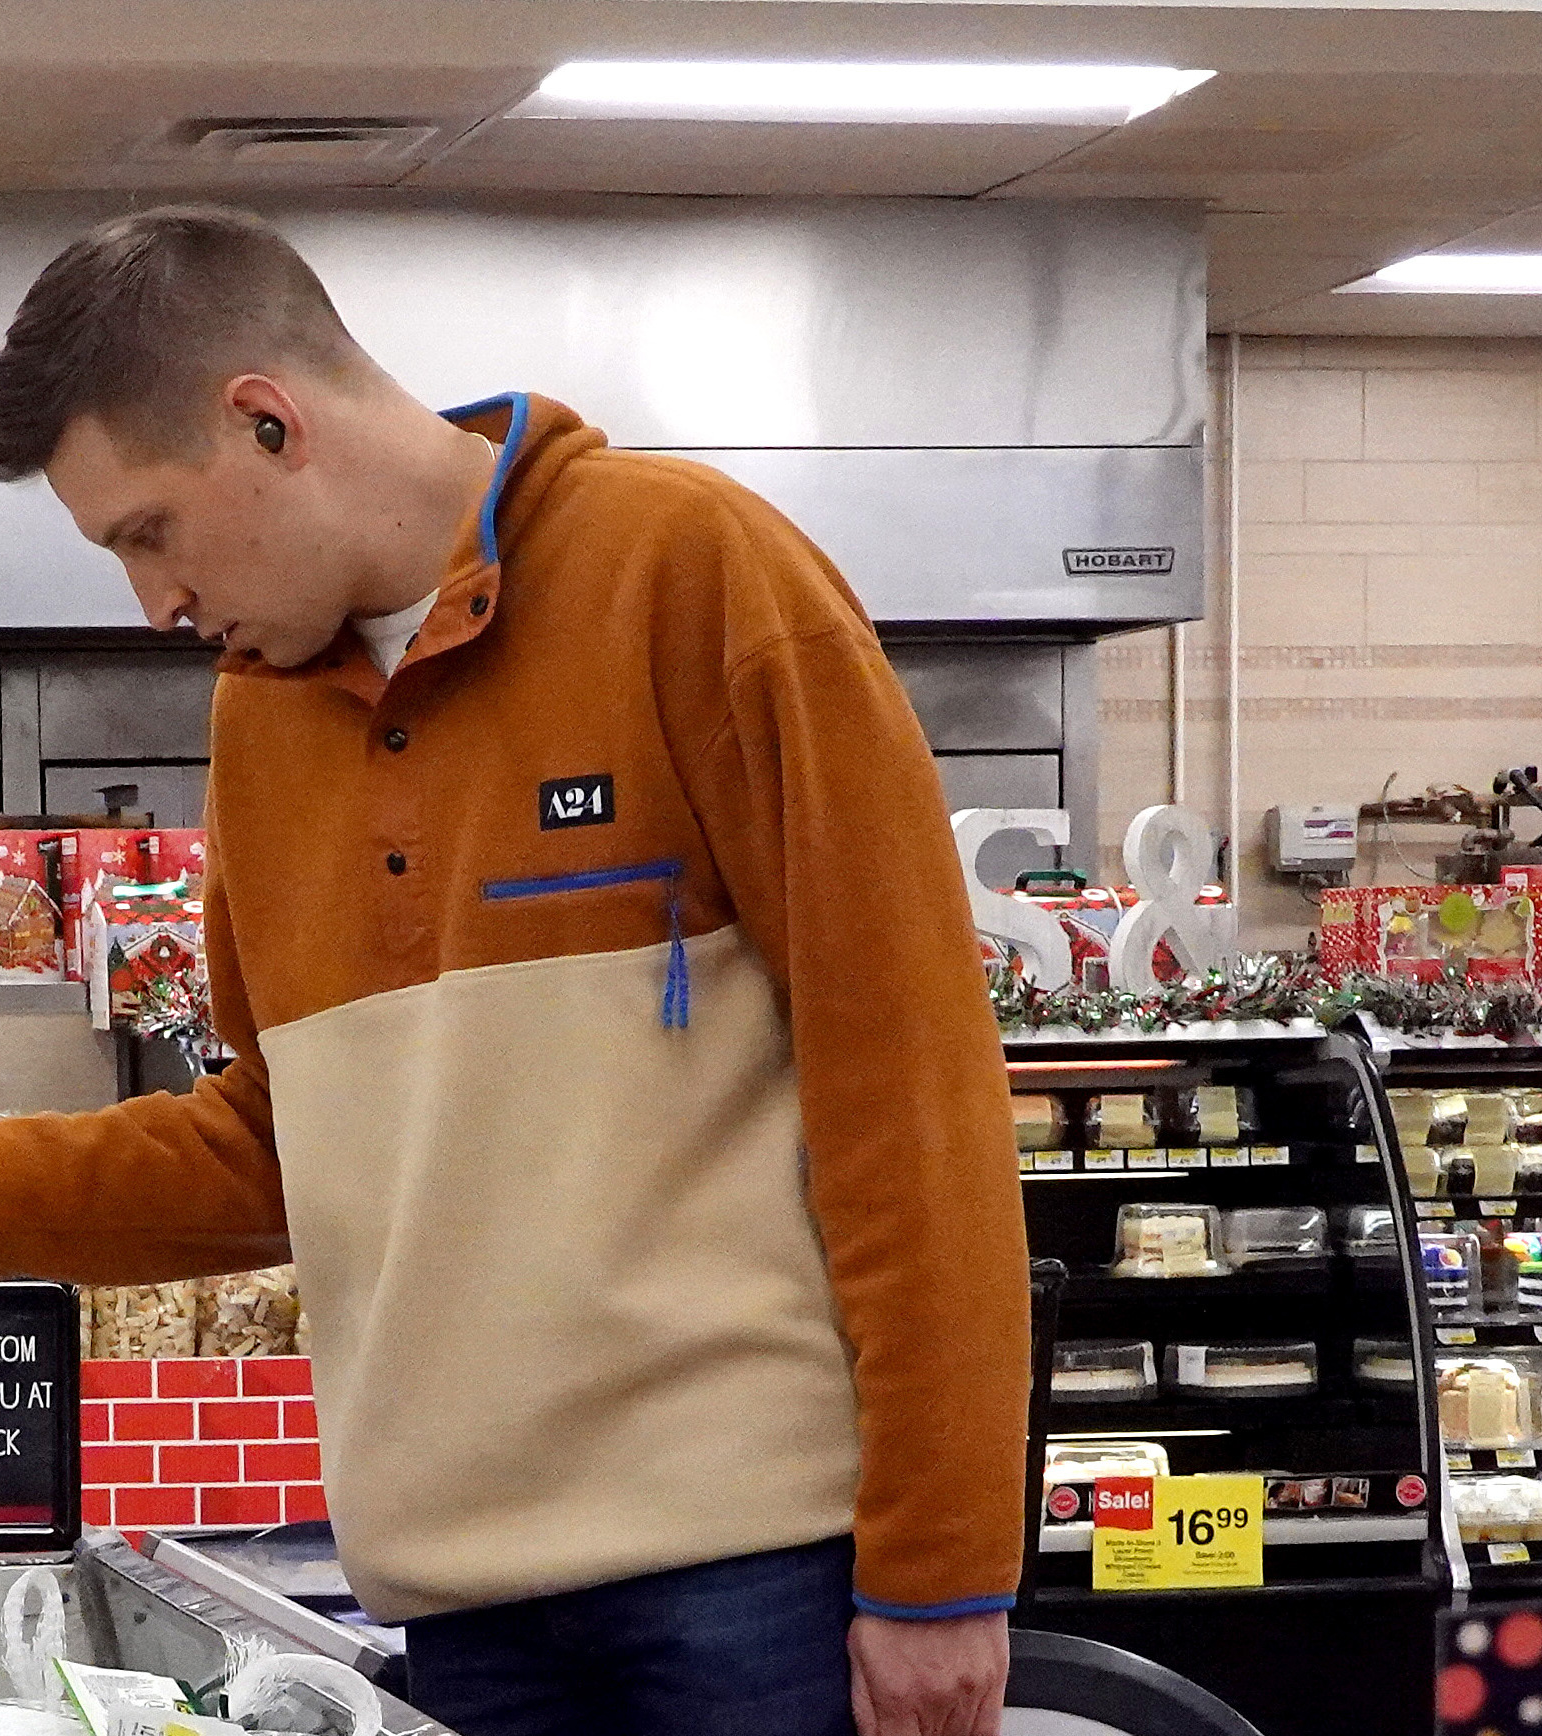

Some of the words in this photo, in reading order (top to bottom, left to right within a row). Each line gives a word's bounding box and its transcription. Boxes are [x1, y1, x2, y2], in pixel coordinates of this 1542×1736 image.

[1075, 553, 1167, 568] HOBART
[546, 784, 603, 820] A24
[26, 1380, 54, 1408] AT
[1097, 1490, 1150, 1510] Sale!
[1168, 1507, 1249, 1546] 1699
